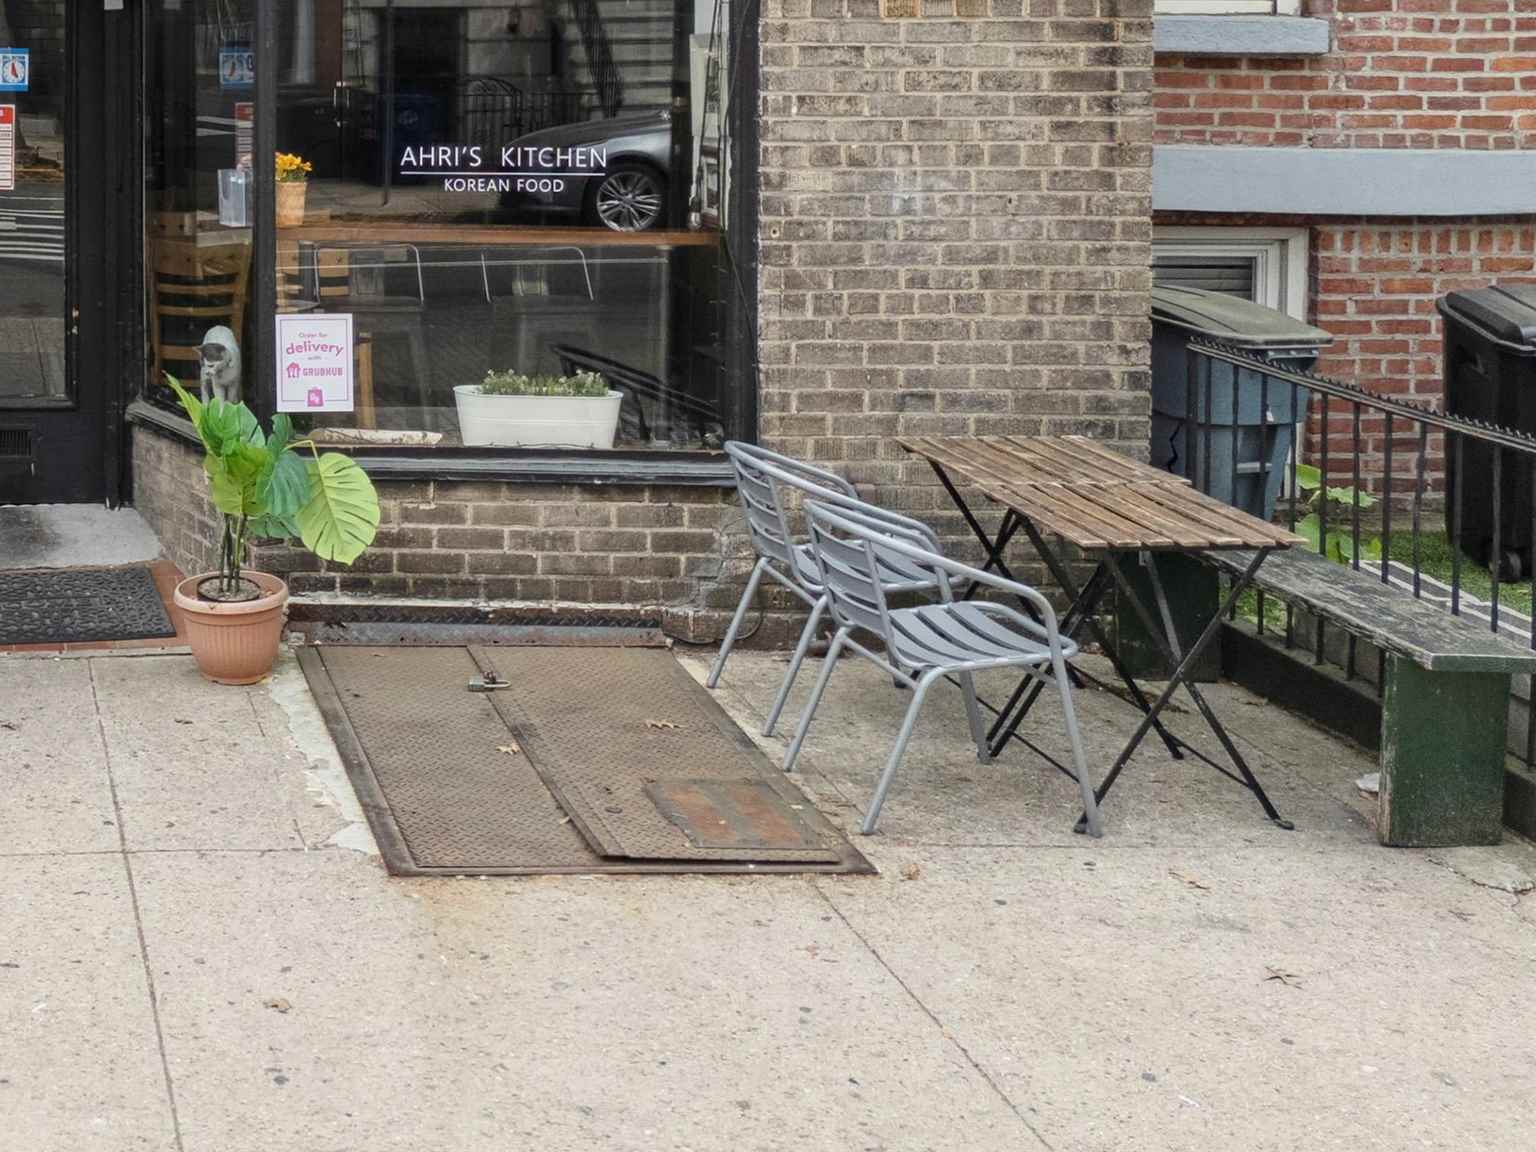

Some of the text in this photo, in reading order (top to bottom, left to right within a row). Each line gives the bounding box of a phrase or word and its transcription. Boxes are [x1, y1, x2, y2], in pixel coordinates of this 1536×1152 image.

[400, 146, 607, 168] AHRI'S KITCHEN
[444, 178, 564, 193] KOREAN FOOD
[286, 340, 344, 356] delivery
